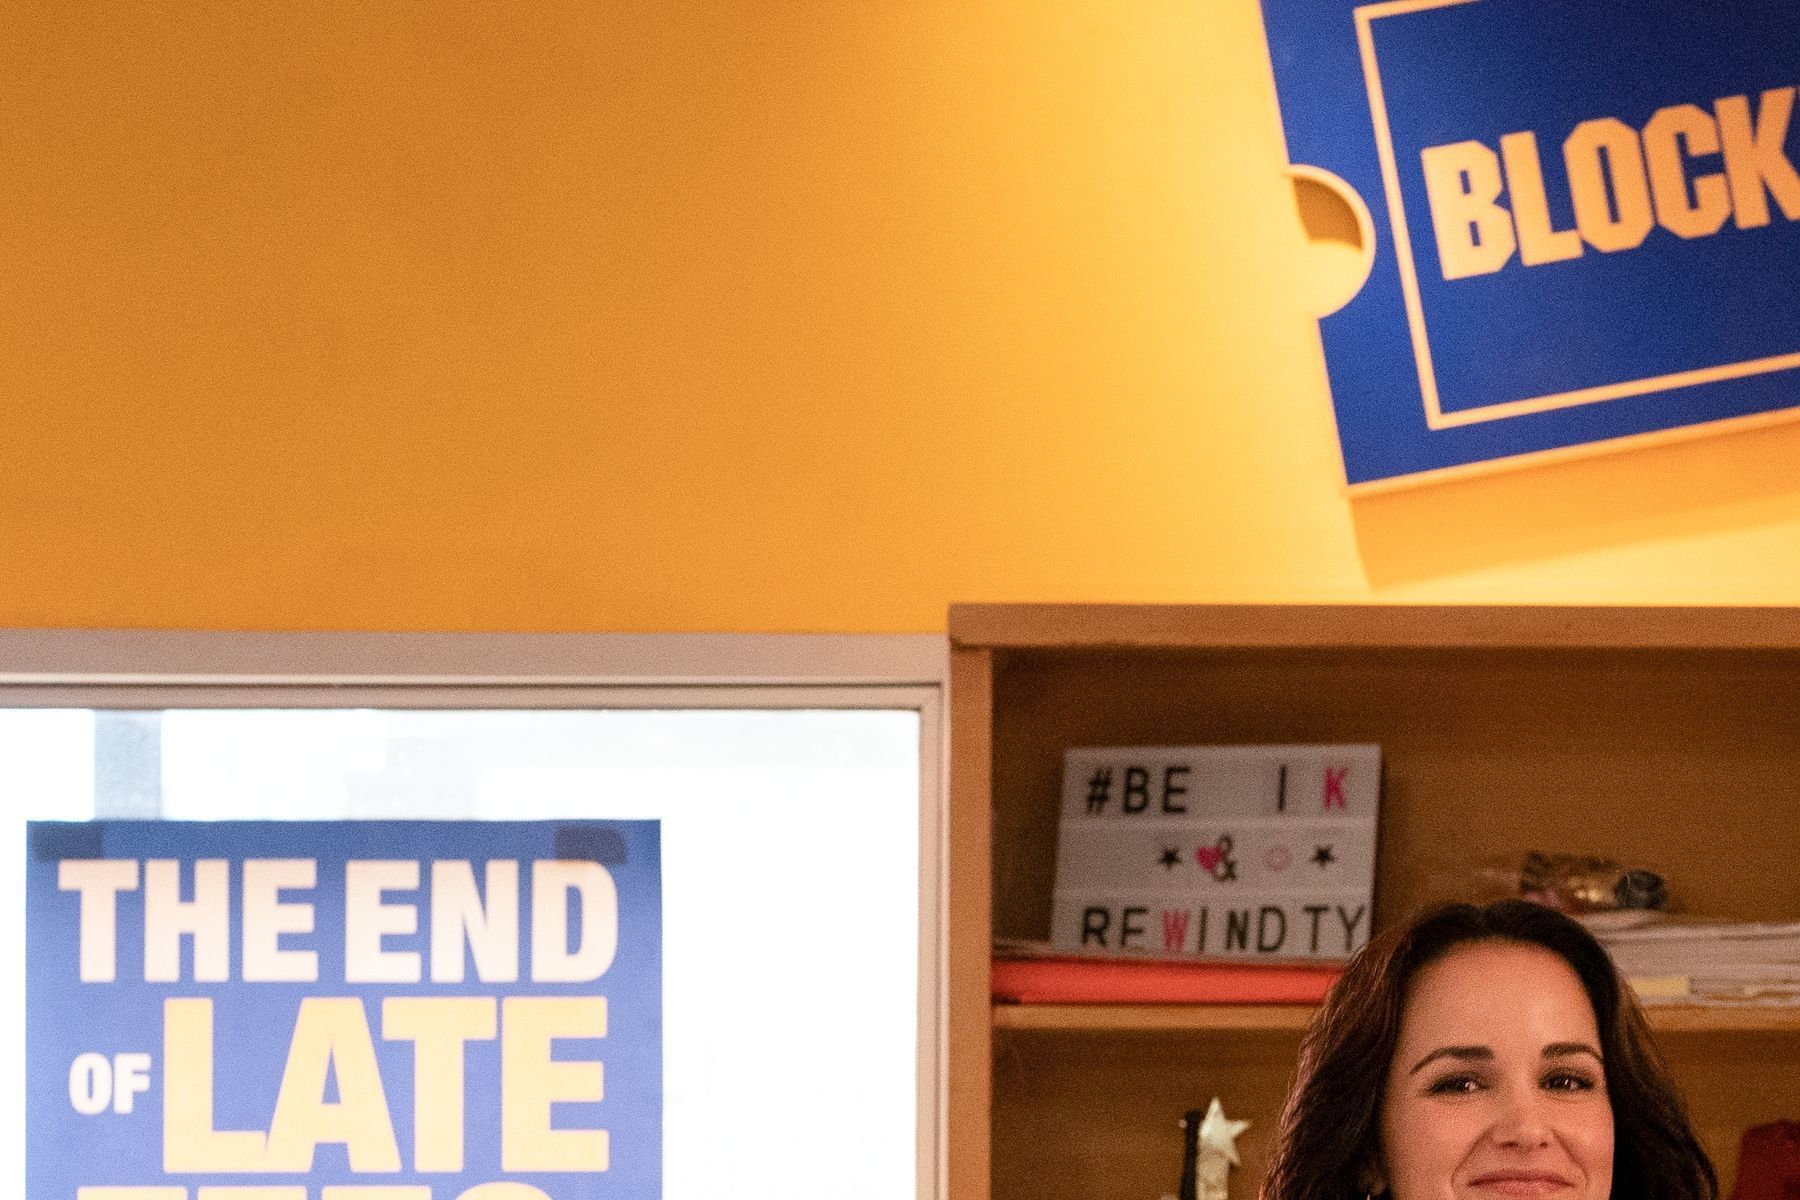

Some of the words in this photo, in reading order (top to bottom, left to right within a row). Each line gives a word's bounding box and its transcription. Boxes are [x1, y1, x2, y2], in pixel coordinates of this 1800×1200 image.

[1085, 766, 1191, 814] #BE
[58, 859, 318, 982] THE
[345, 859, 619, 983] END
[69, 1054, 151, 1114] OF
[163, 996, 609, 1173] LATE
